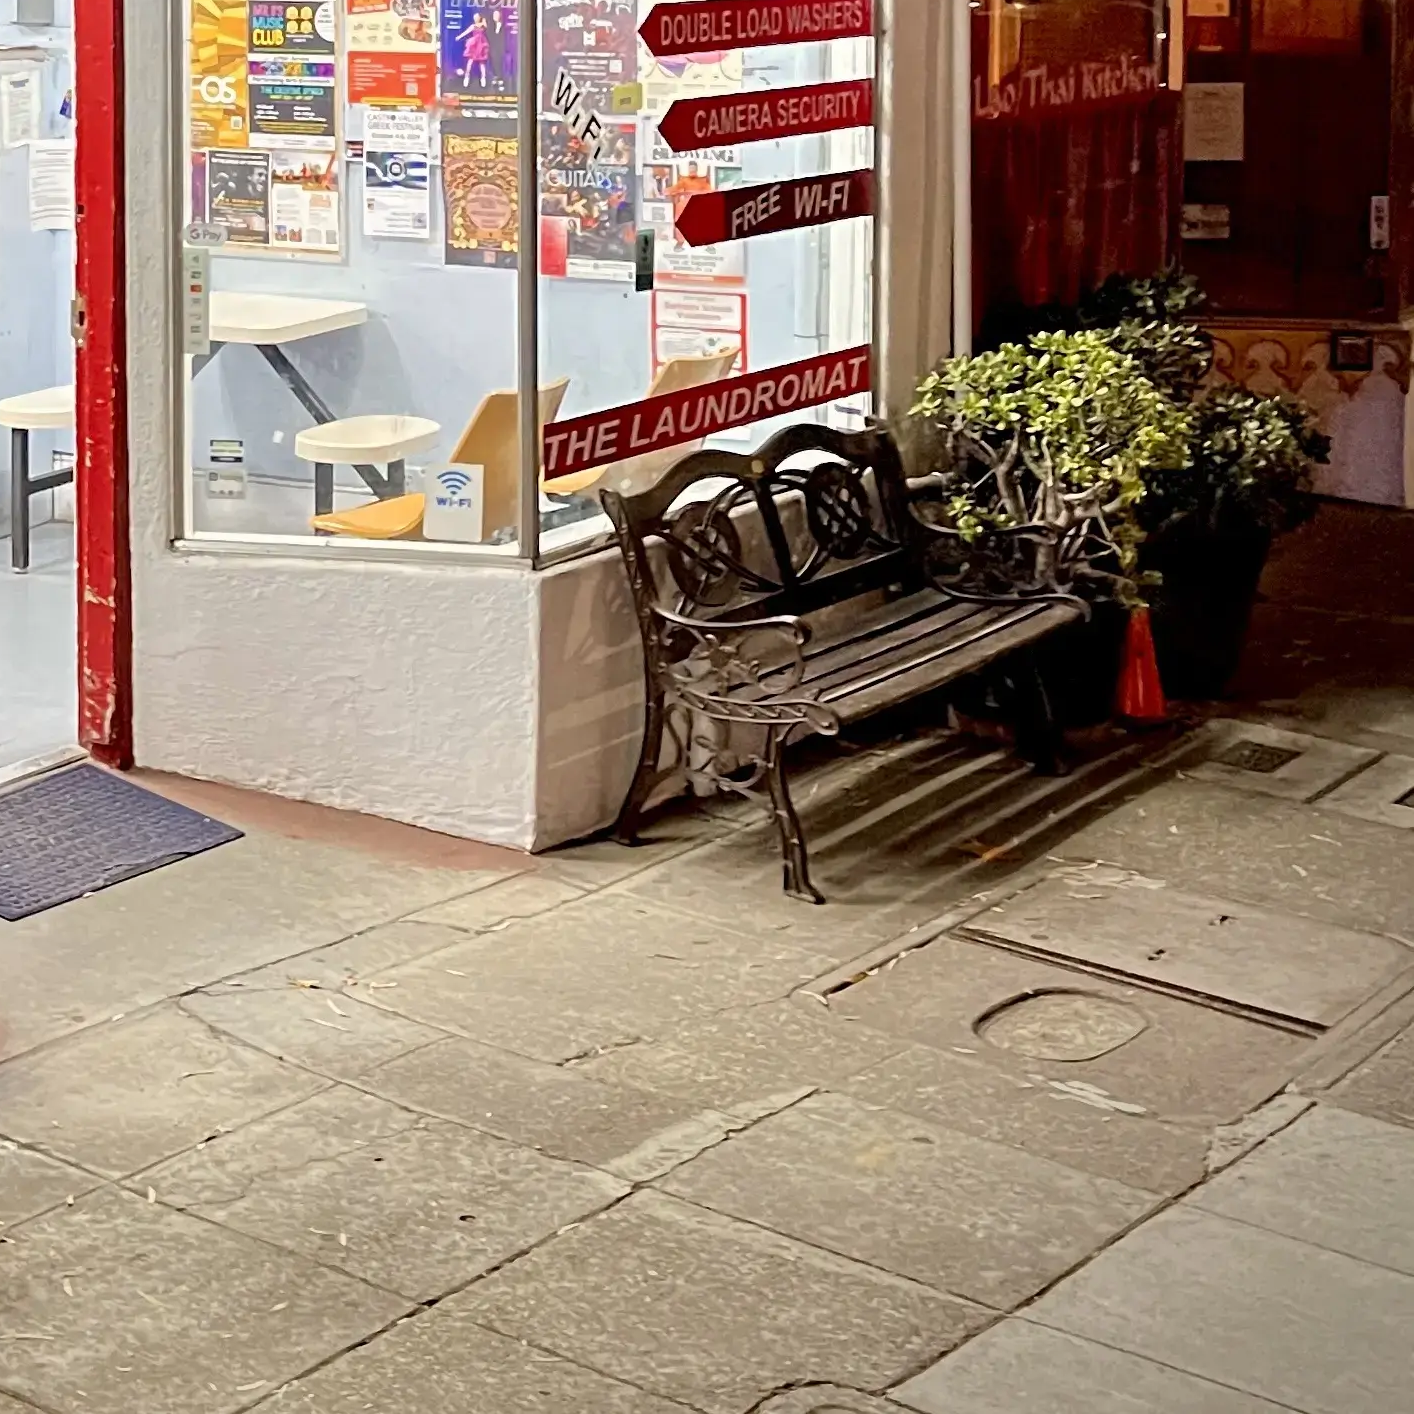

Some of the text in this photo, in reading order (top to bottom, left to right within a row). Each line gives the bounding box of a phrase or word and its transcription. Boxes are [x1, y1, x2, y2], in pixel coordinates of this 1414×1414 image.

[252, 29, 284, 46] CLUB
[660, 0, 864, 46] DOUBLE LOAD WASHERS
[693, 90, 861, 138] CAMERA SECURITY
[731, 180, 851, 239] FREE WI-FI
[544, 355, 868, 471] THE LAUNDROMAT
